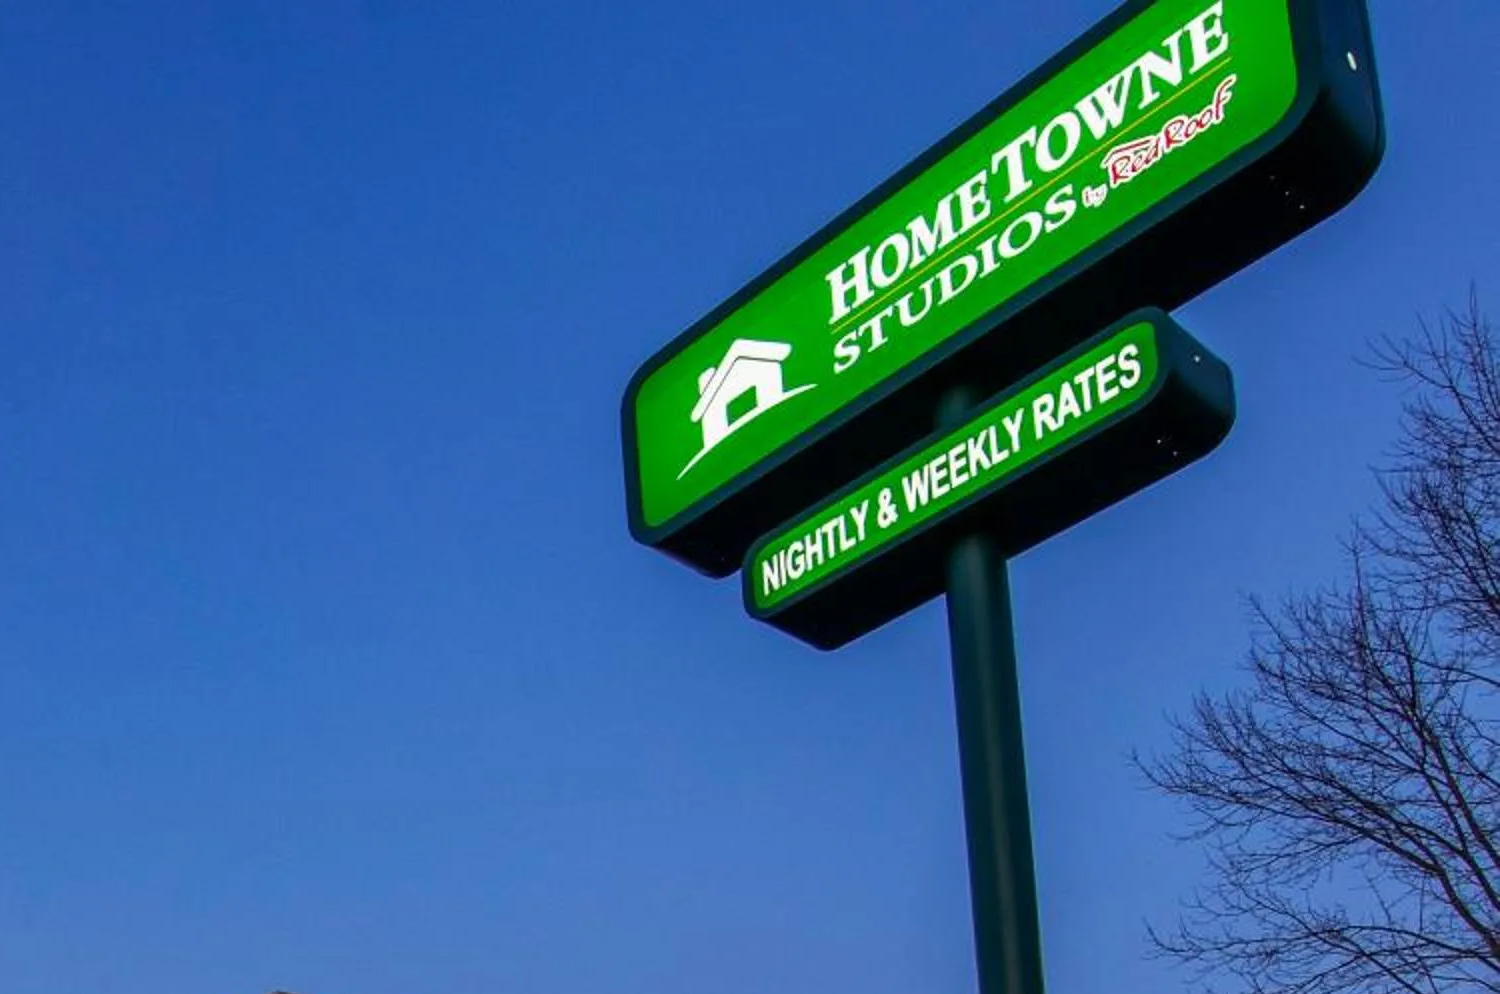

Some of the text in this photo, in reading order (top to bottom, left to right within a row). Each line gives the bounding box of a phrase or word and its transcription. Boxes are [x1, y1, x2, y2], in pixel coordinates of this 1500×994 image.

[833, 184, 1077, 373] STUDIOS
[761, 343, 1141, 596] NIGHTLY & WEEKLY RATES
